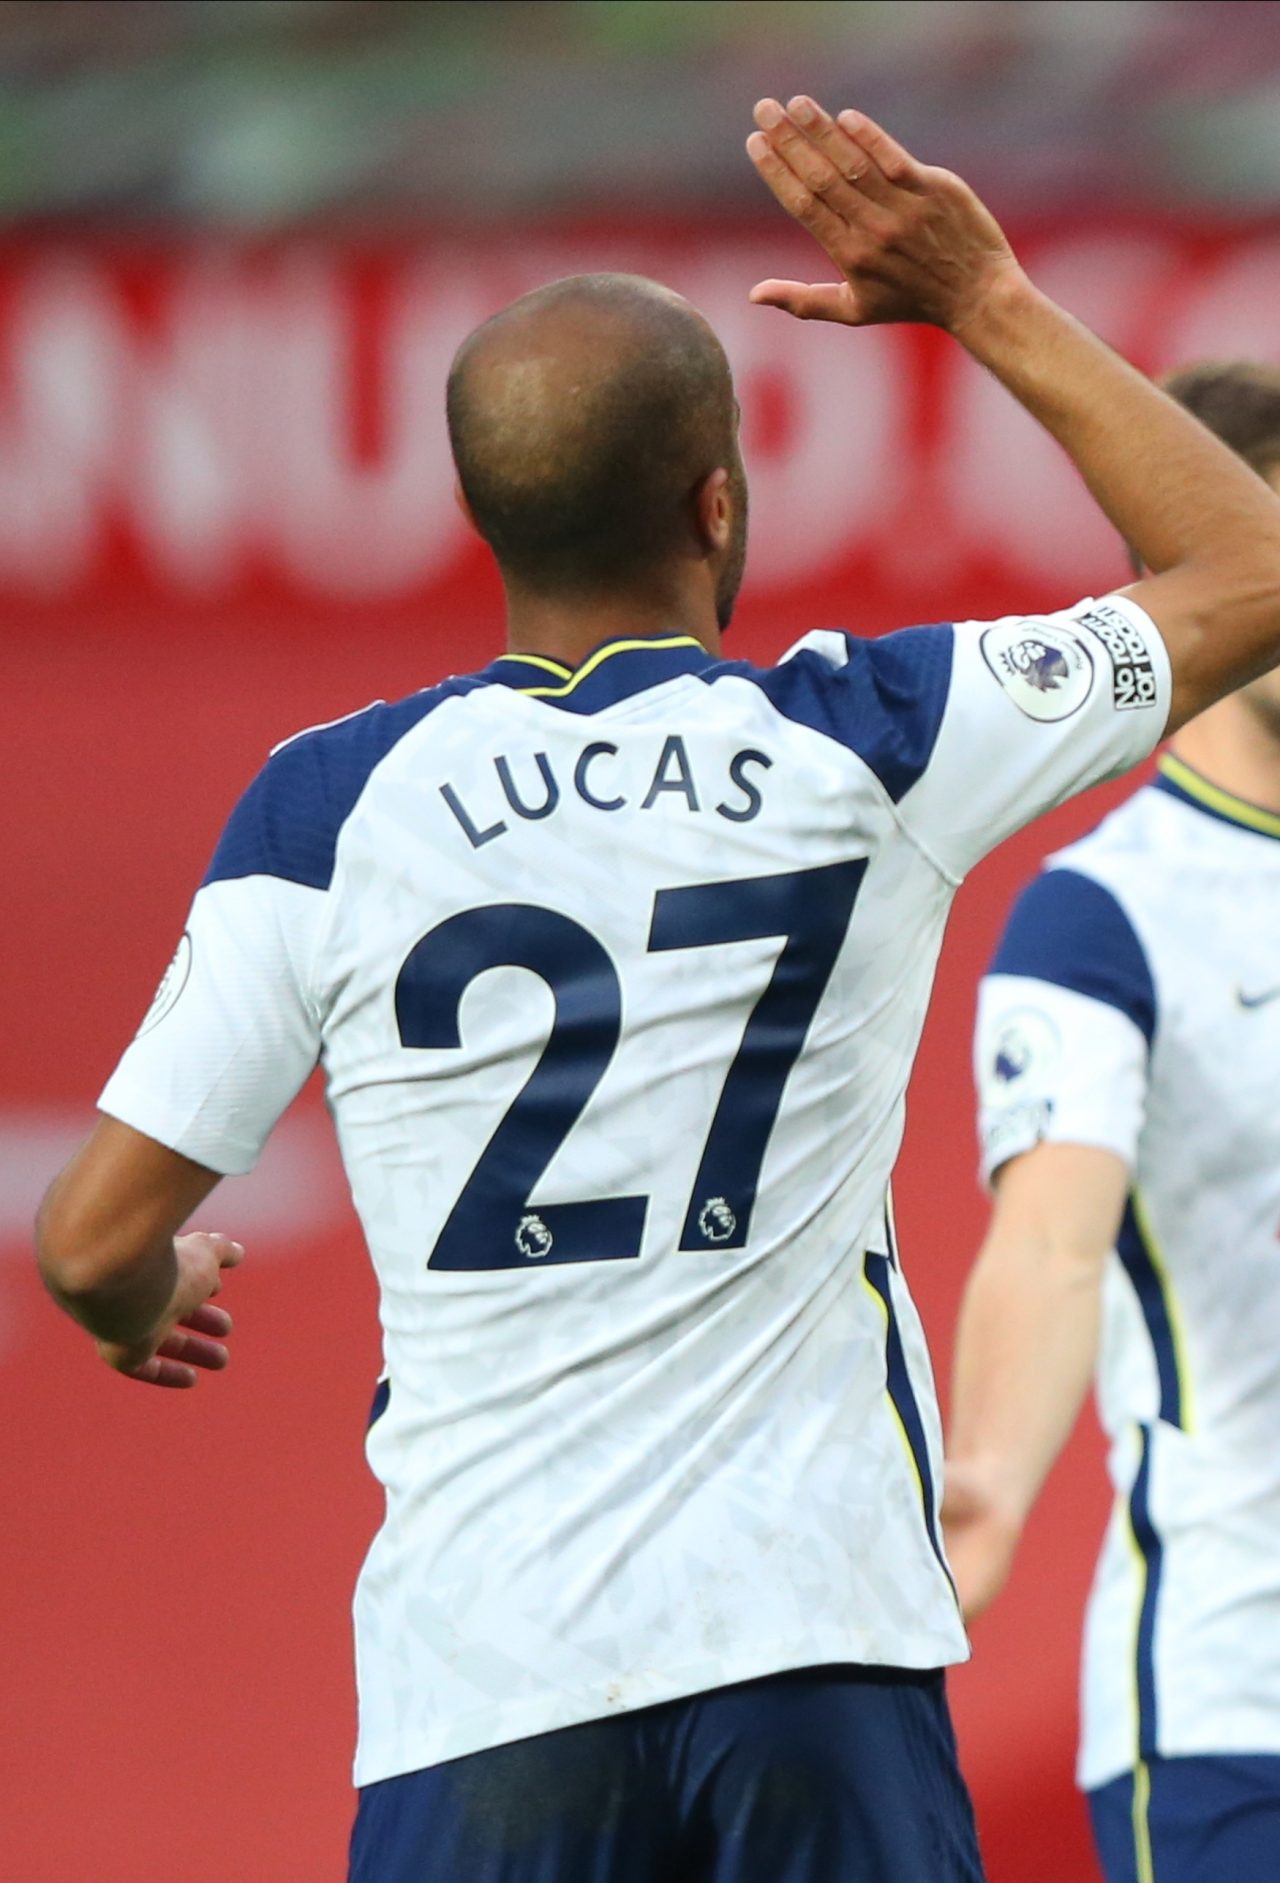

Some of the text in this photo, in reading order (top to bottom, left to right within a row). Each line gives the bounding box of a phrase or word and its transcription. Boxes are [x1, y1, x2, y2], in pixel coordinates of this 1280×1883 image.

[1114, 667, 1136, 709] No
[439, 734, 774, 849] LUCAS
[394, 856, 870, 1271] 27
